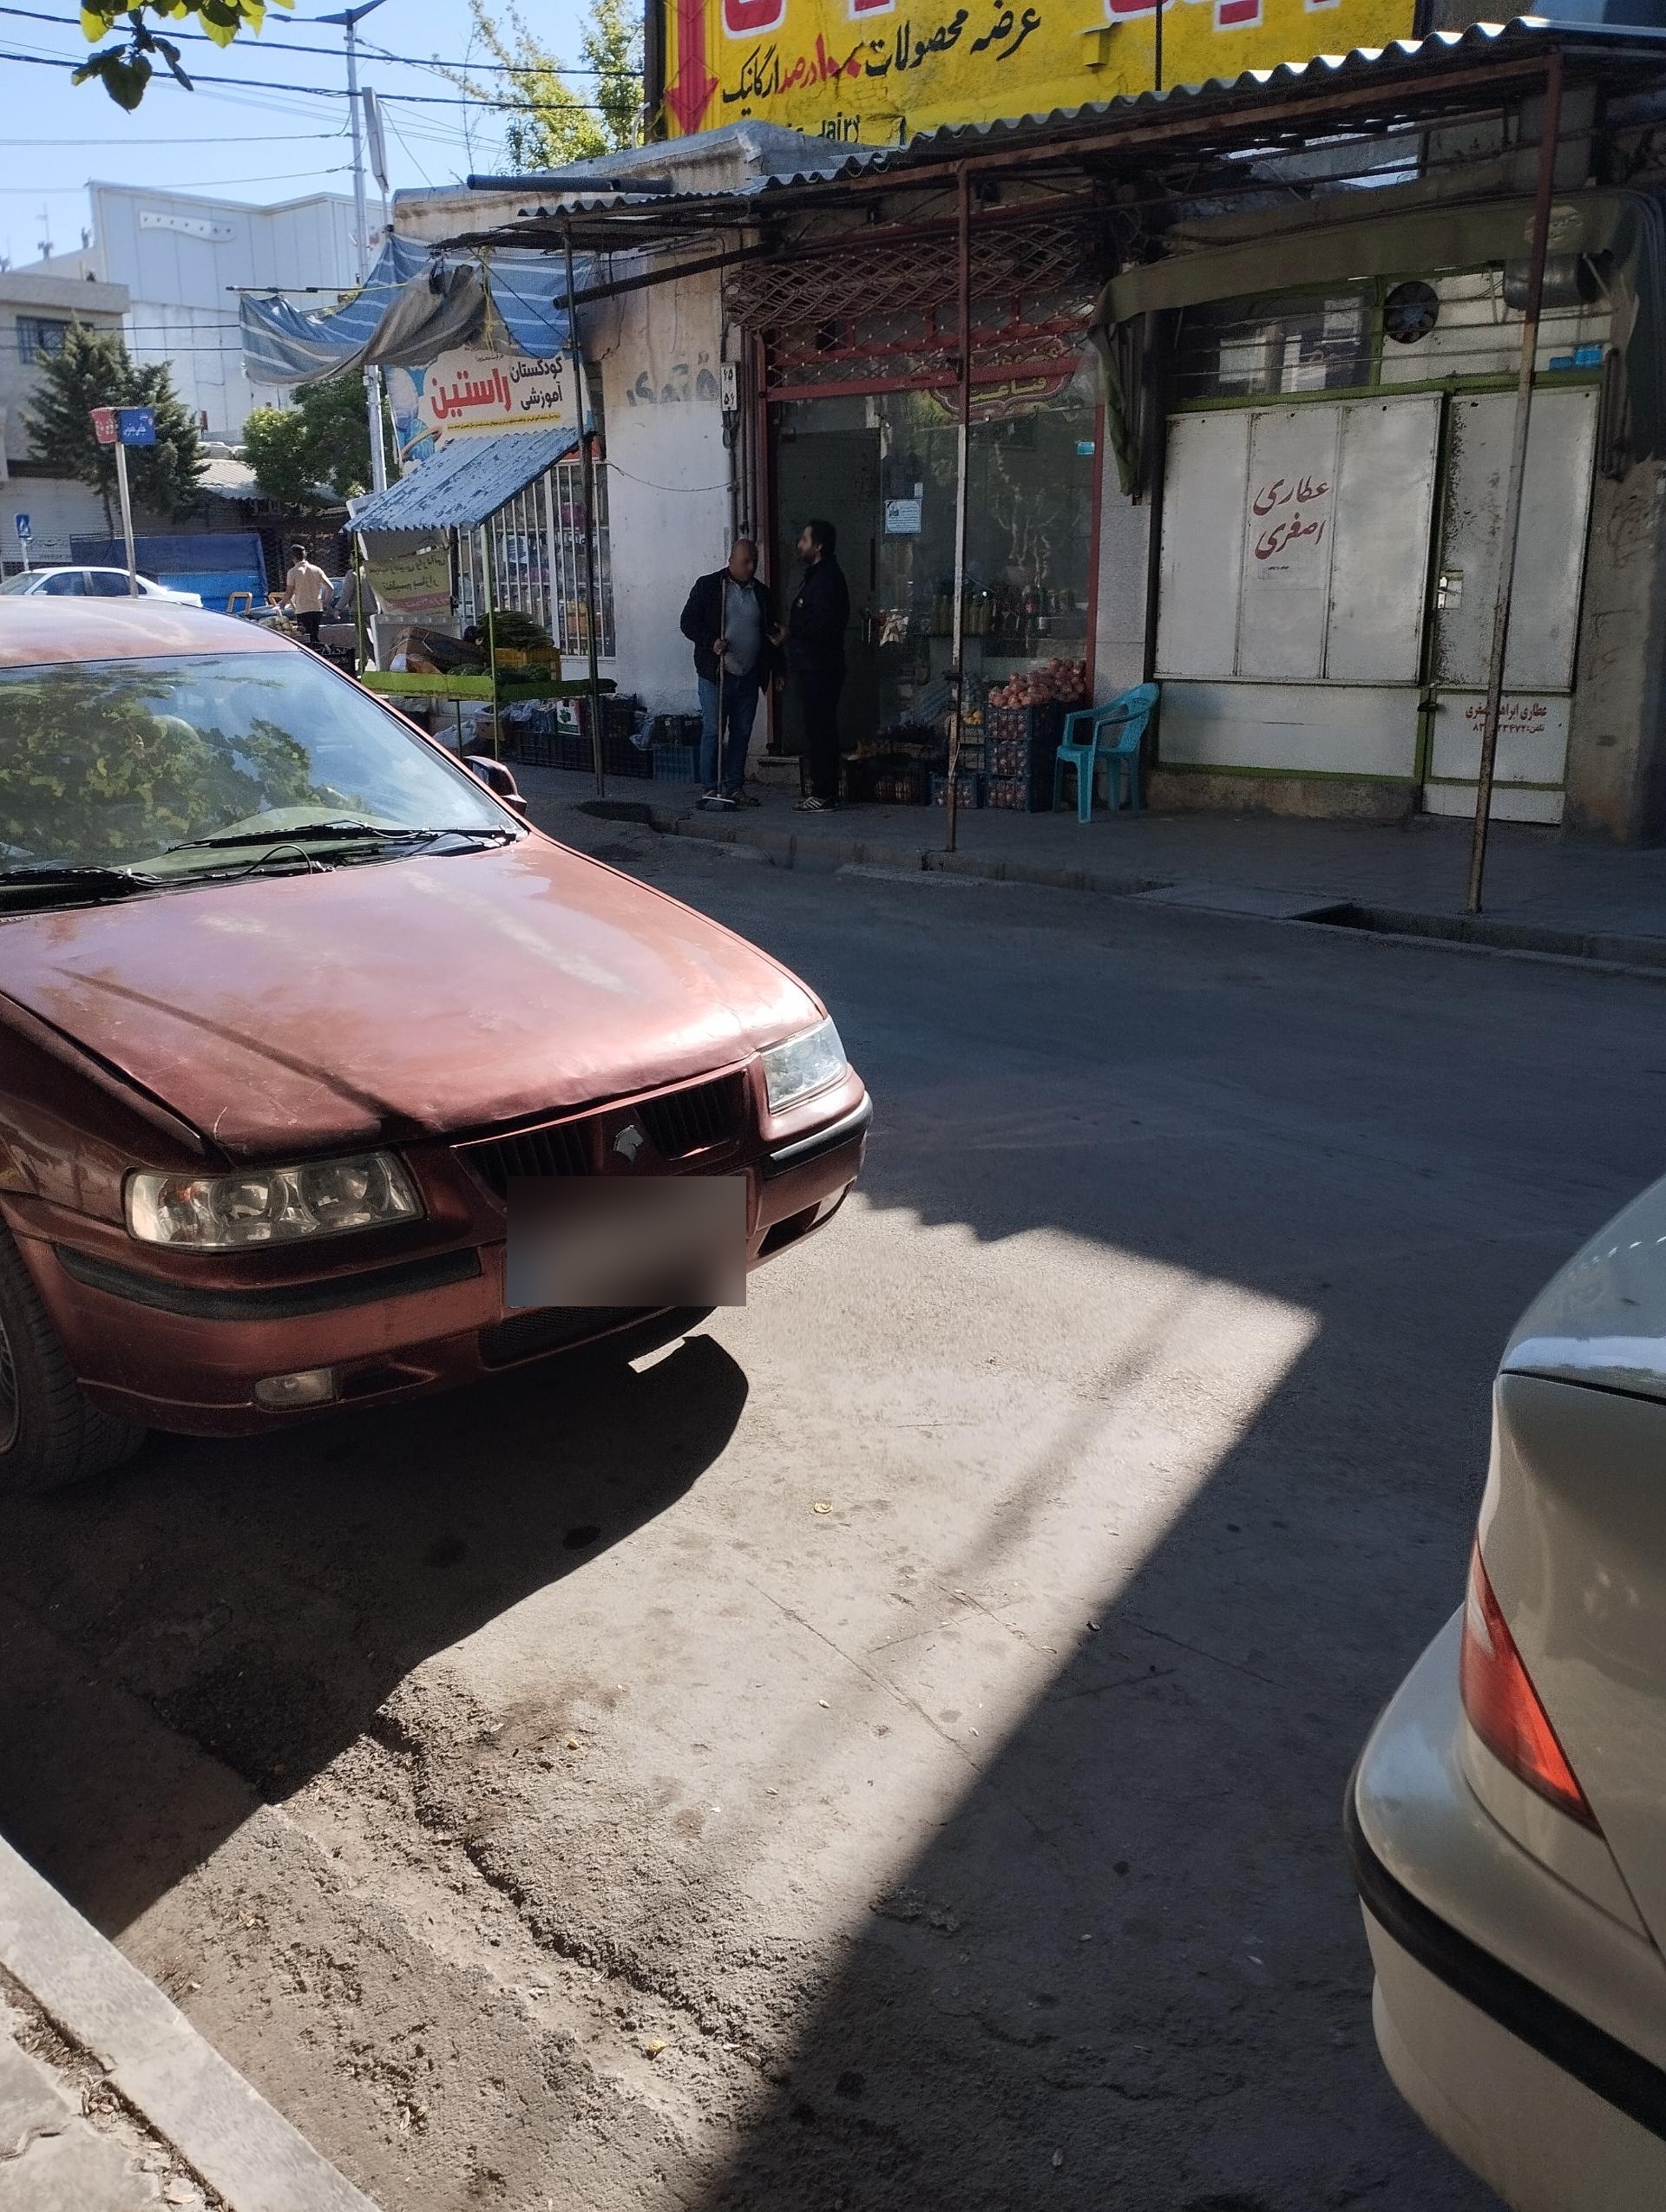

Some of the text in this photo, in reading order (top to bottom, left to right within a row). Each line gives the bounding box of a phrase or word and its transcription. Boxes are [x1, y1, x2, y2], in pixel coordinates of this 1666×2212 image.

[865, 9, 969, 76] محصولات
[969, 0, 1041, 61] عرضه
[722, 43, 779, 115] ارگانیک
[430, 356, 563, 419] راستین کودکستان
[521, 382, 563, 411] آموزشی
[1253, 475, 1329, 515] عطاری
[1255, 512, 1326, 560] اصغری
[1466, 703, 1490, 719] صغری
[1520, 703, 1547, 721] عطاری
